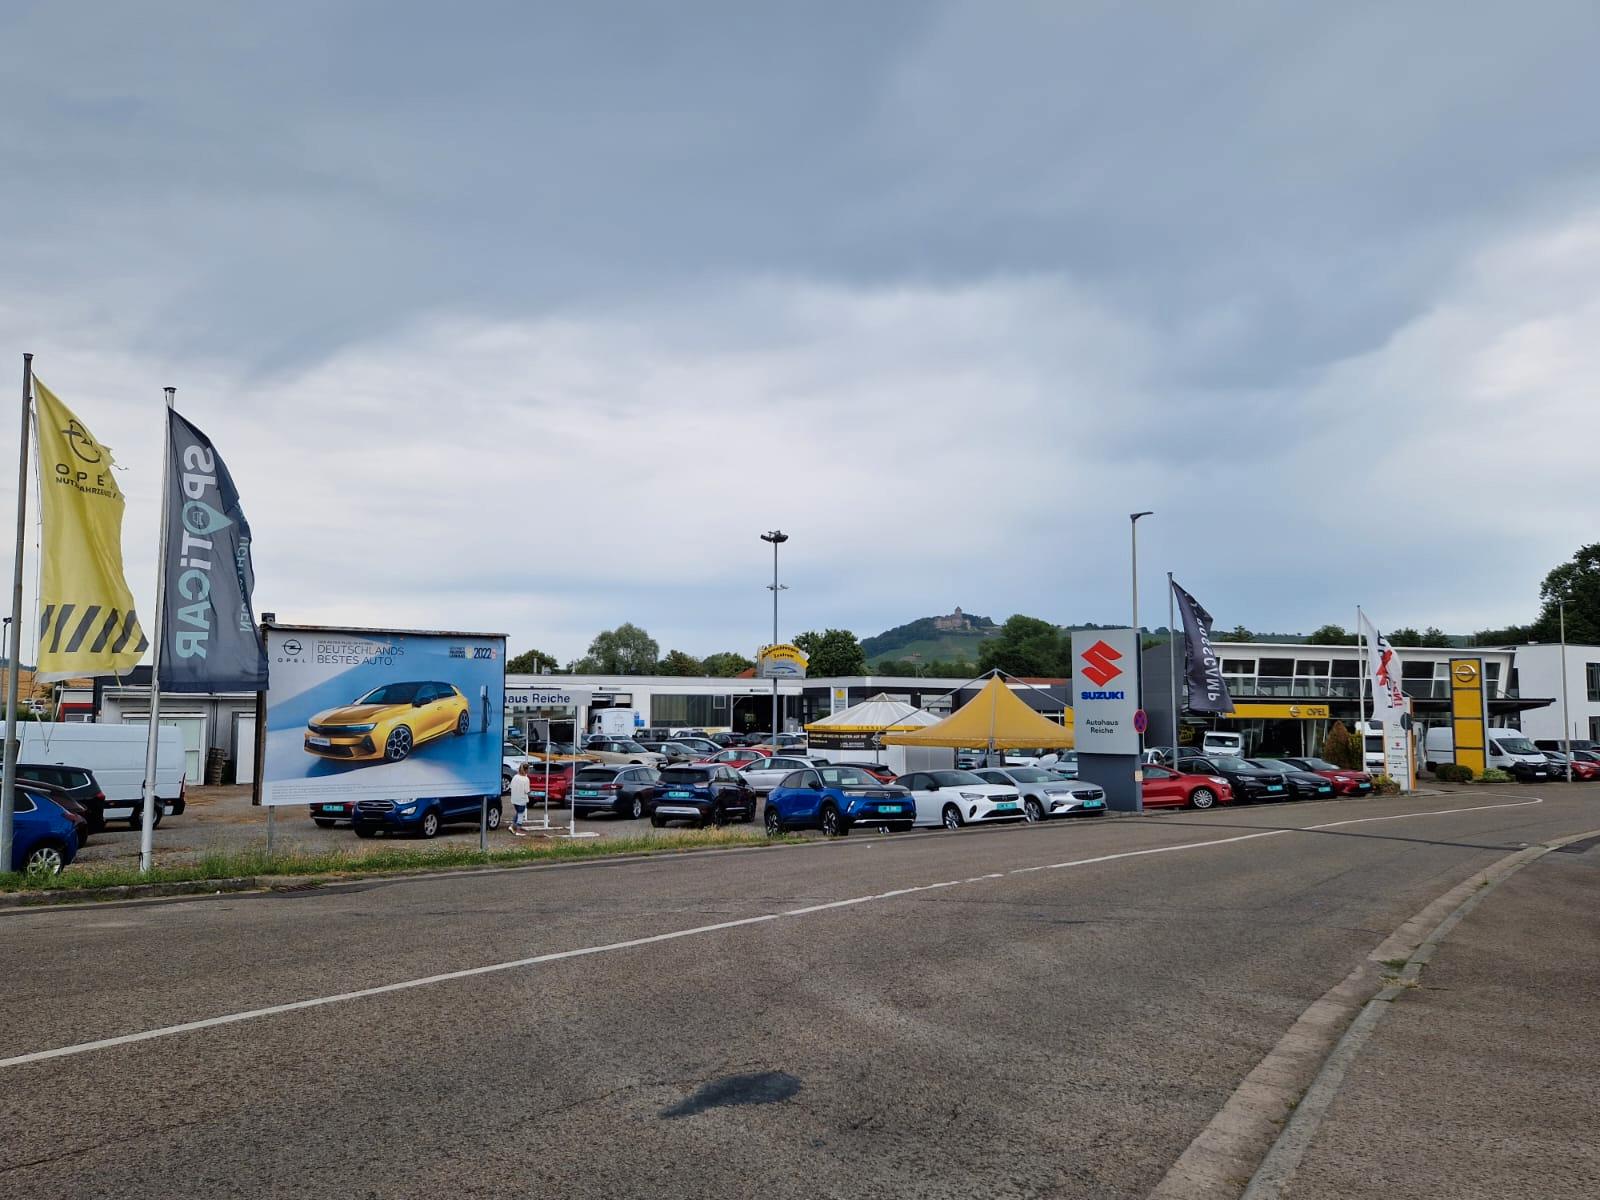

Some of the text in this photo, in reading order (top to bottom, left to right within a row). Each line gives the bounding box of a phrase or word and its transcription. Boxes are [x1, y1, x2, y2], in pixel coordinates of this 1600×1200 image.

[317, 644, 404, 656] DEUTSCHLANDS
[473, 647, 491, 659] 2022
[317, 654, 359, 664] BESTES
[532, 693, 571, 703] Reiche
[1081, 691, 1124, 700] SUZUKI
[1306, 708, 1327, 716] OPEL
[1090, 726, 1114, 734] Reiche
